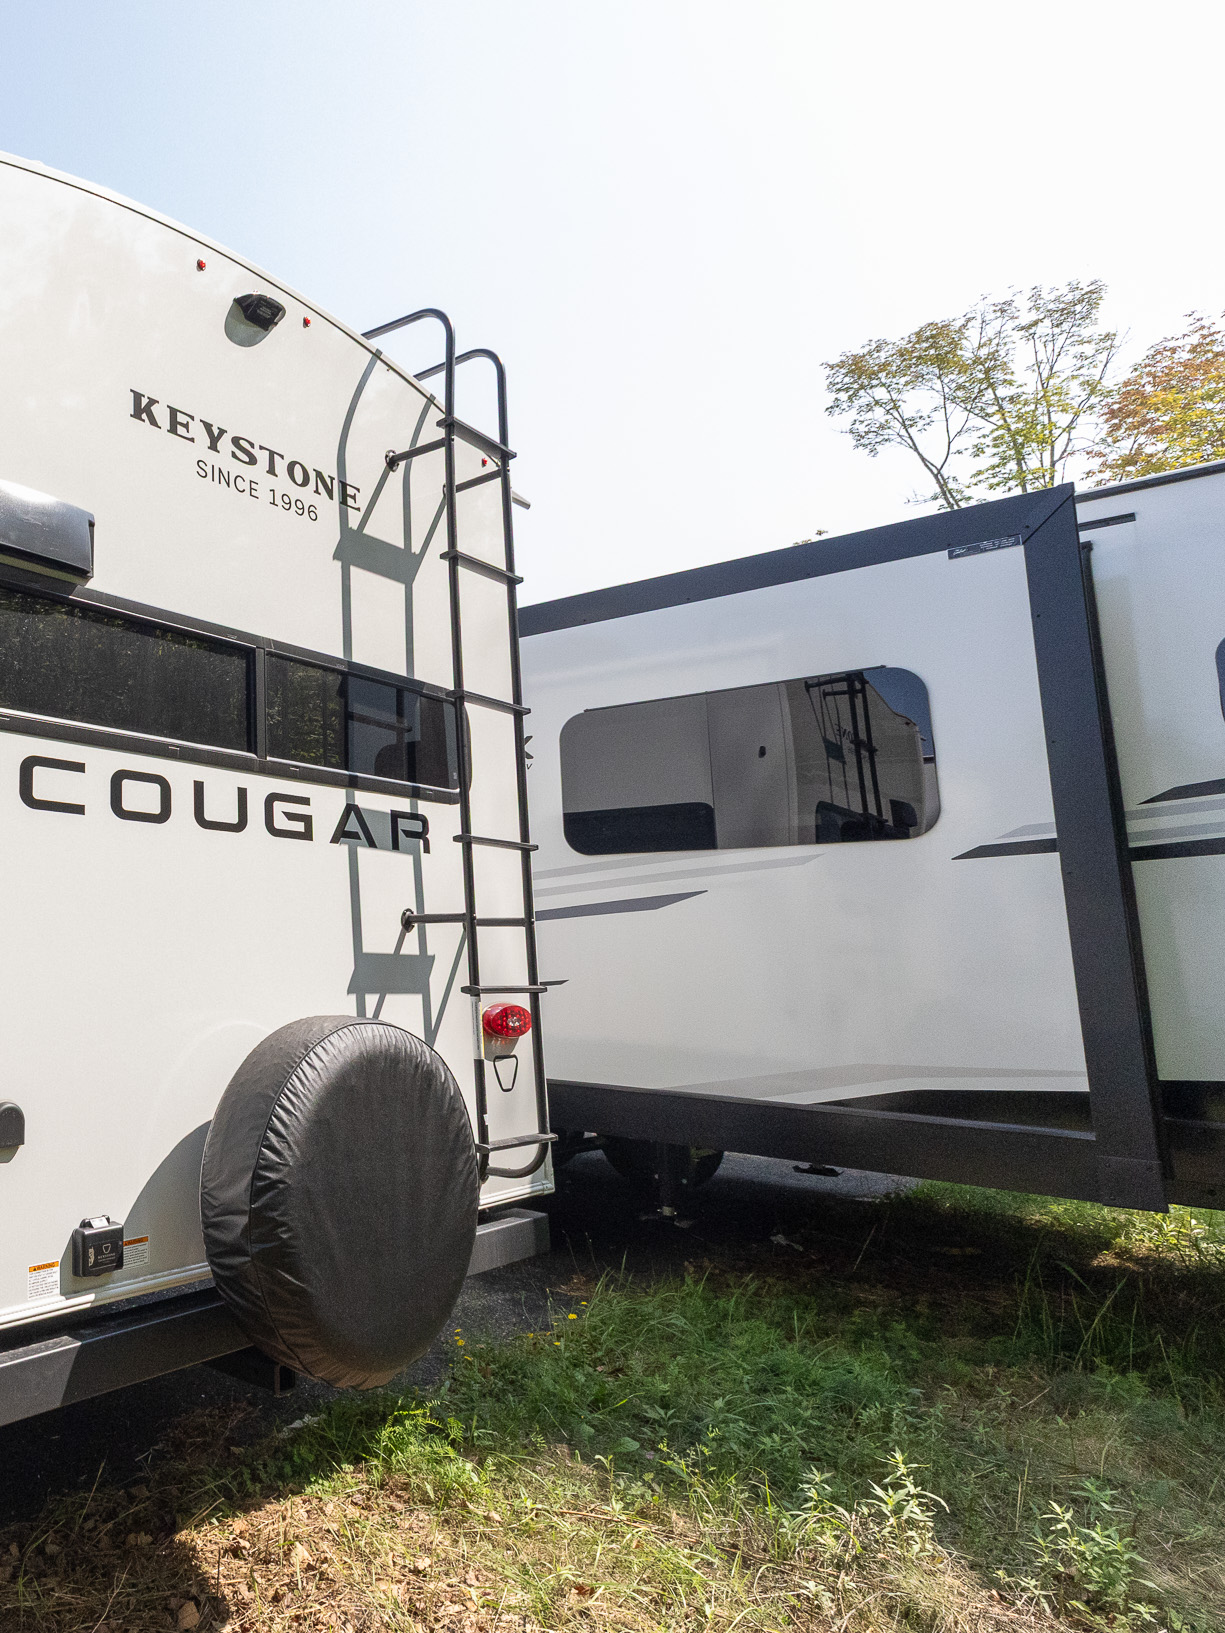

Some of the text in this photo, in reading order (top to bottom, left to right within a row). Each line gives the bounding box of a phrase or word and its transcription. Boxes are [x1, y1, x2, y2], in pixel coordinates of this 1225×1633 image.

[130, 388, 361, 512] KEYSTONE
[196, 459, 319, 522] SINCE 1996
[19, 754, 431, 854] COUGAR
